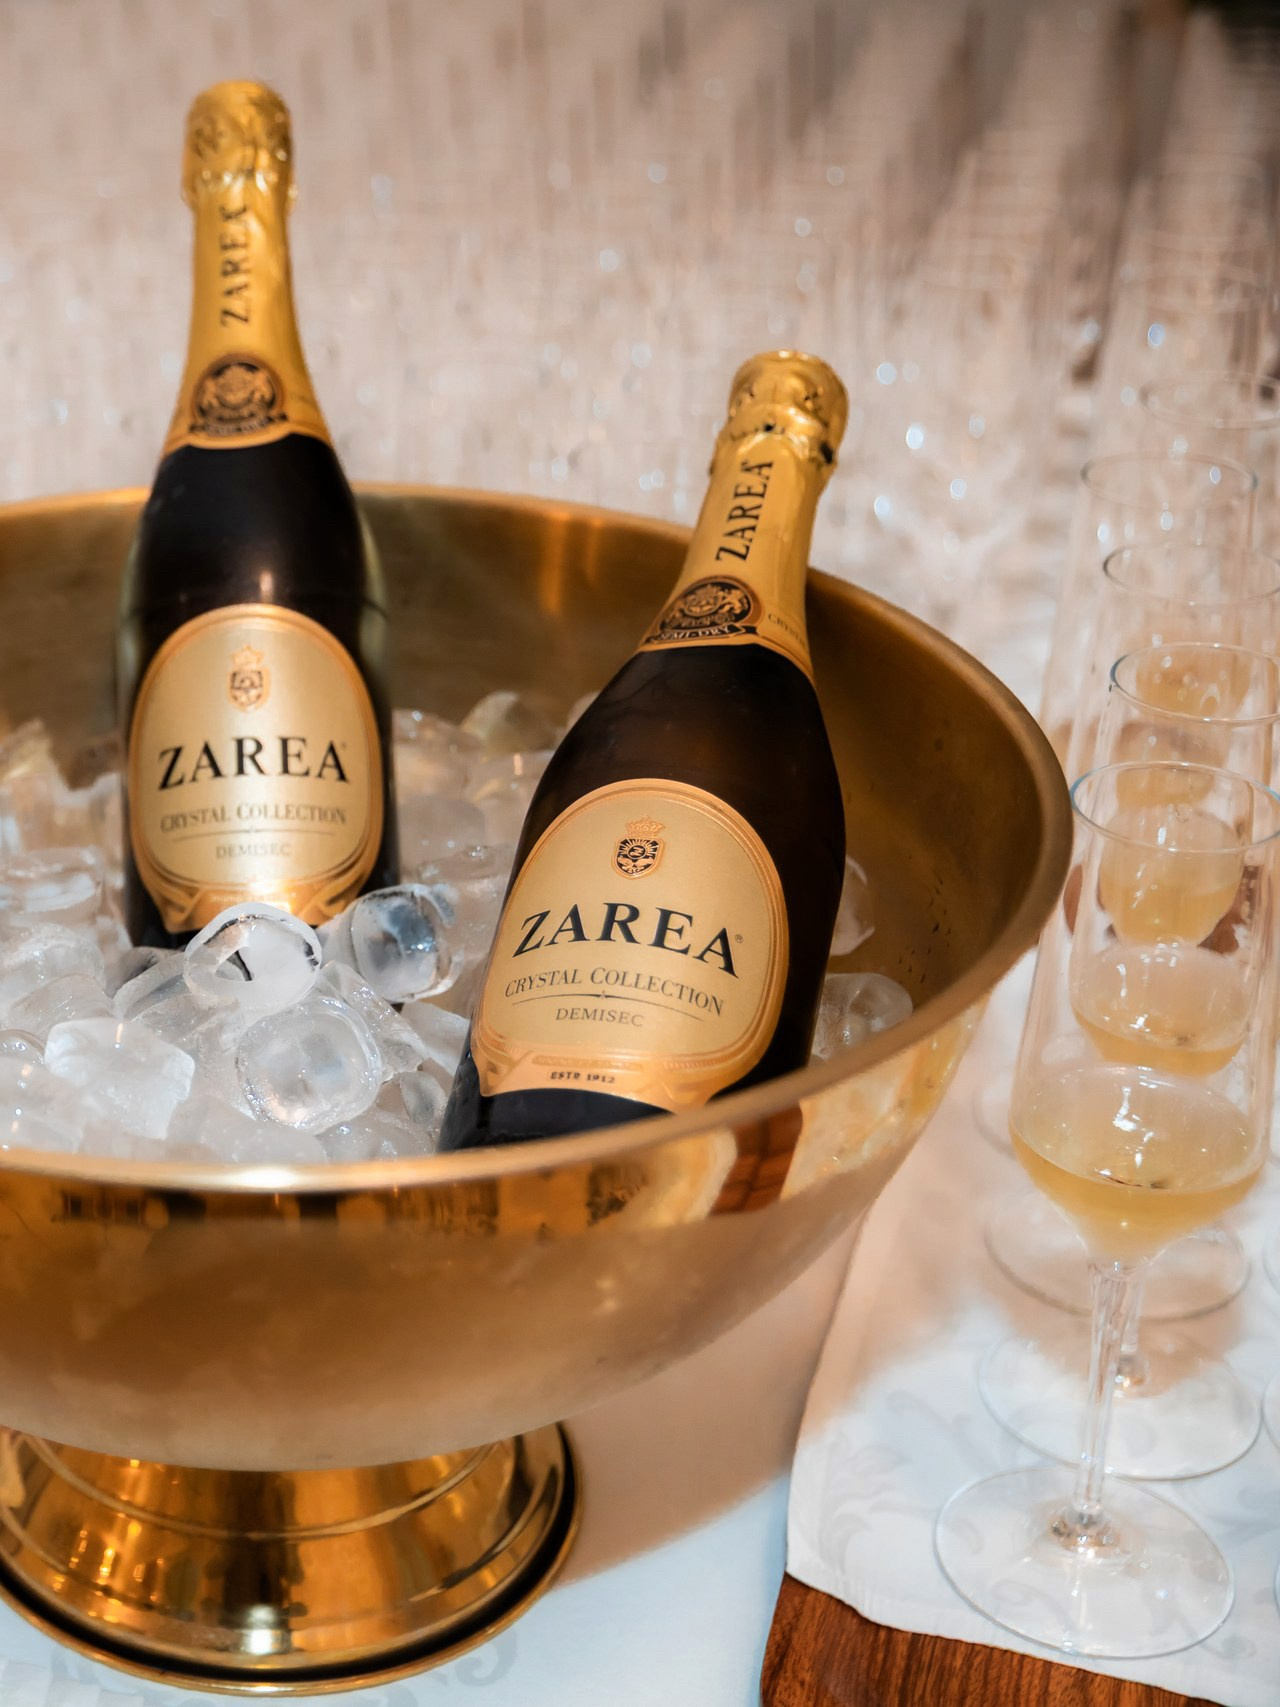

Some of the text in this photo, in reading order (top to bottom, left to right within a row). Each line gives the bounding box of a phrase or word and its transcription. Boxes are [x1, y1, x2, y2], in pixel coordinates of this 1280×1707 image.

[715, 459, 774, 562] ZAREA
[657, 624, 731, 640] MI-DRY
[157, 735, 350, 791] ZAREA
[159, 801, 347, 834] CRYSTAL COLLECTION
[215, 843, 291, 860] DEMISEC
[504, 966, 726, 1018] CRYSTAL COLLECTION
[555, 1007, 645, 1028] DEMISEC
[586, 1073, 617, 1084] 1912
